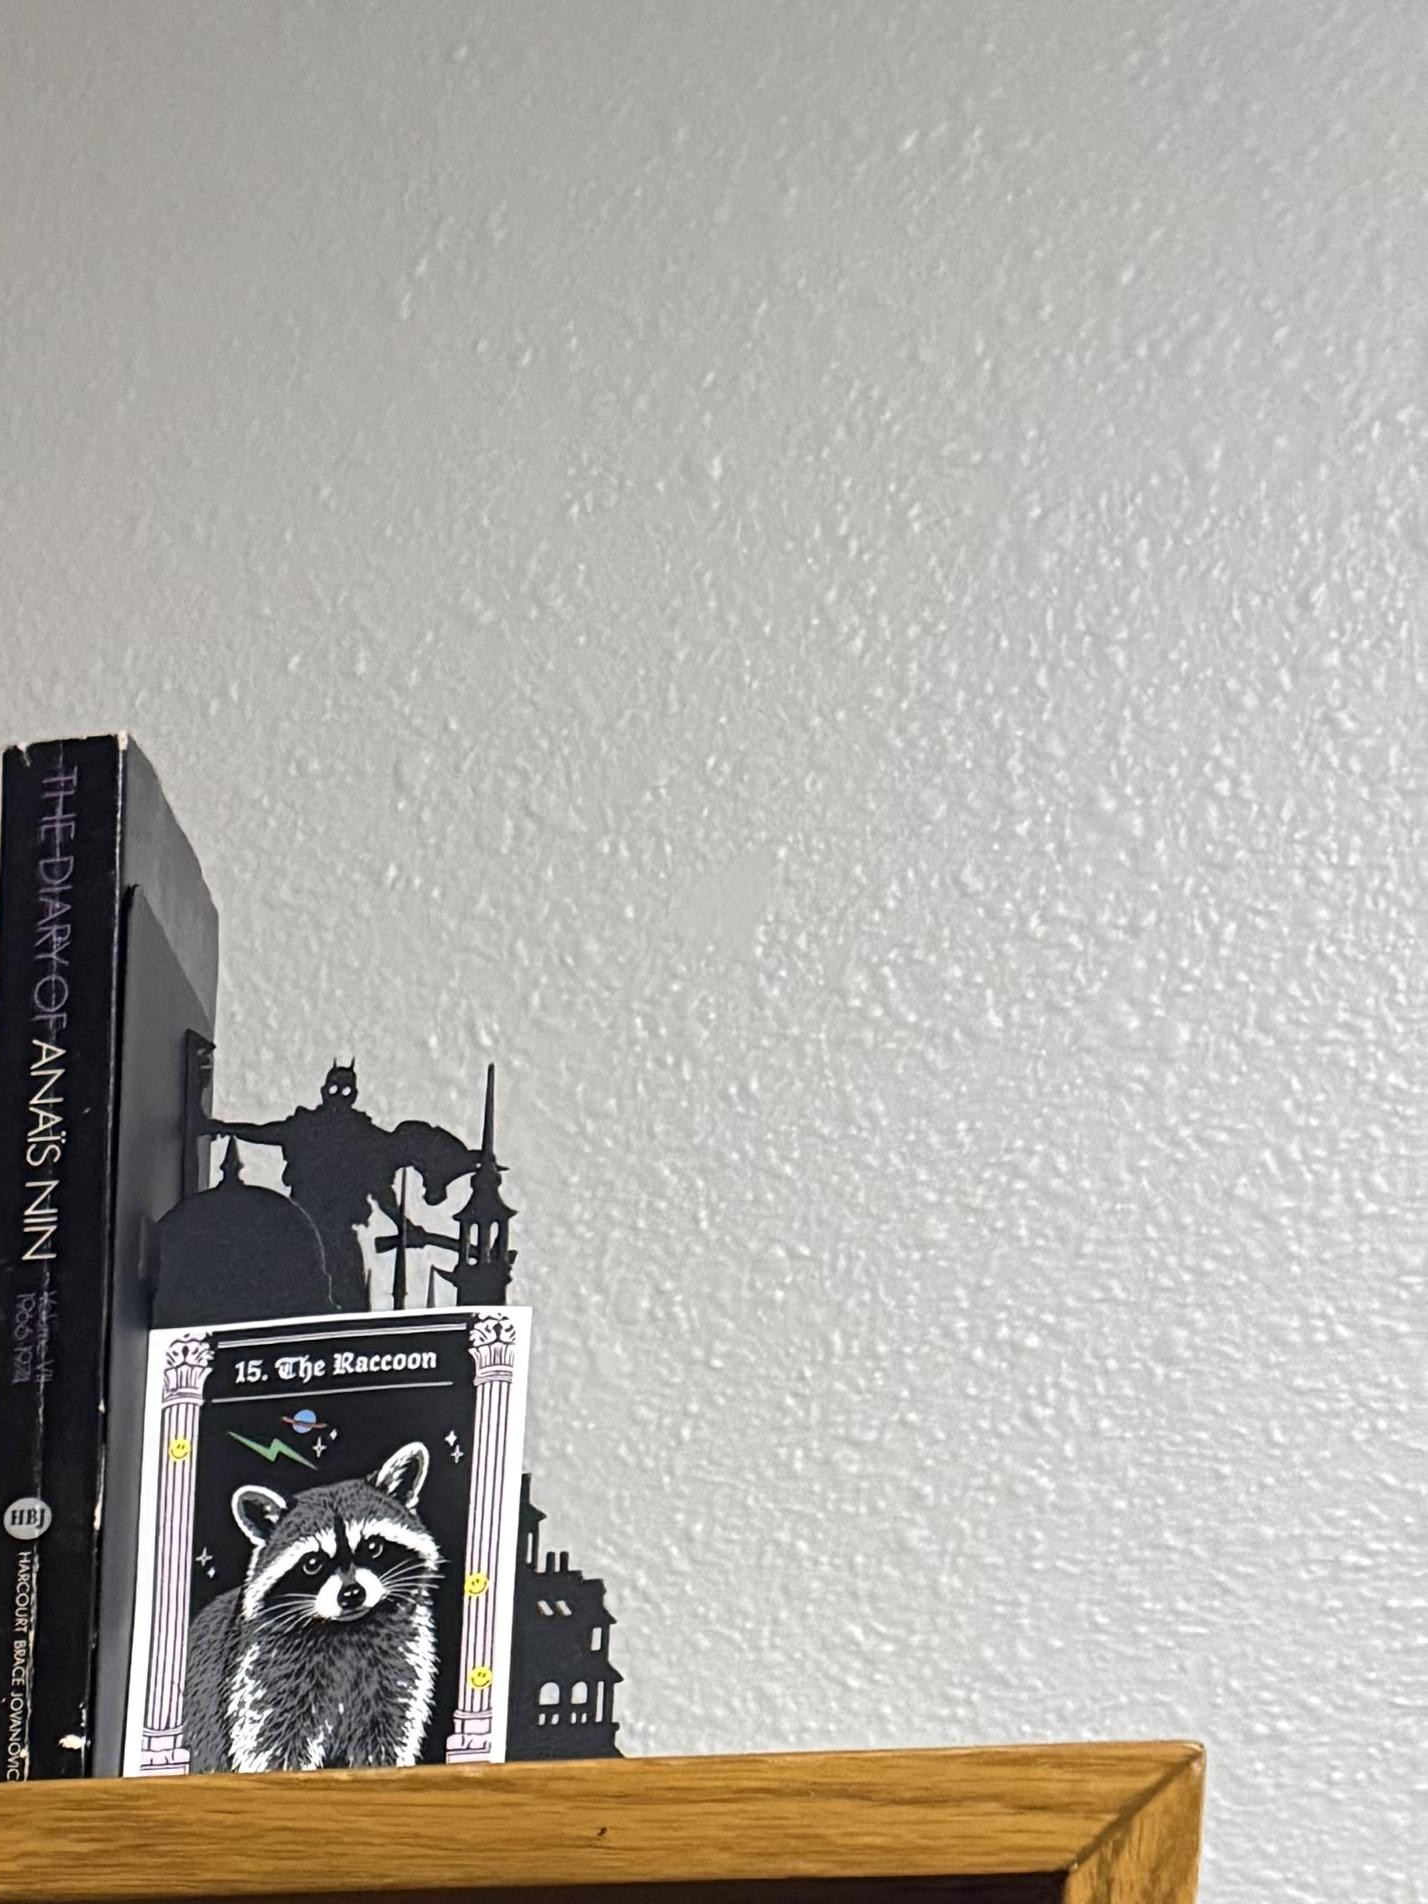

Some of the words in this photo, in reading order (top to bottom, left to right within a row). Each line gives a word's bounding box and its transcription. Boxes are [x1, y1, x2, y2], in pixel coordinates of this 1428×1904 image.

[234, 1360, 268, 1384] 15.
[275, 1356, 326, 1384] The
[332, 1349, 438, 1376] Raccoon
